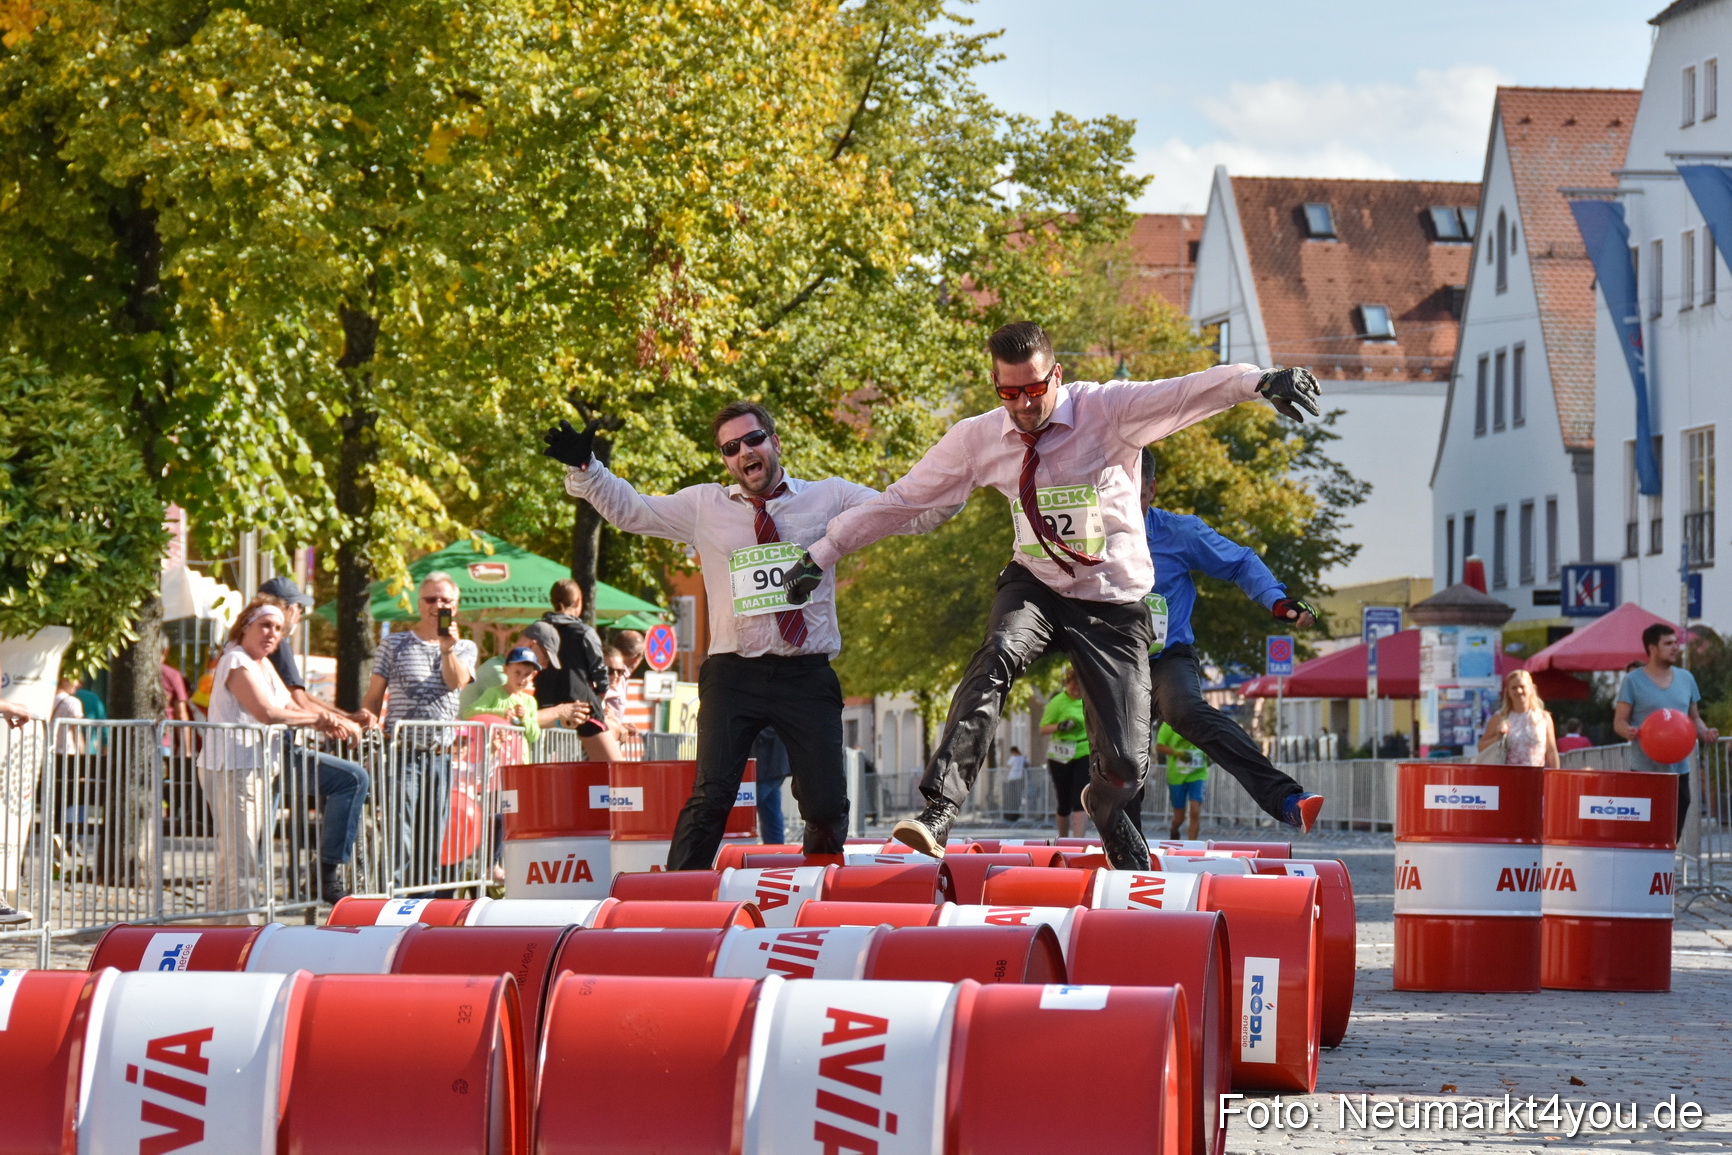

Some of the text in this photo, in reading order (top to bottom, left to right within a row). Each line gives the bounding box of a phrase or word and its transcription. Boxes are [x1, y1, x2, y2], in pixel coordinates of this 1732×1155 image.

[1036, 487, 1091, 510] OCK
[734, 544, 799, 569] BOCK
[460, 585, 544, 594] eumarkter
[753, 567, 785, 590] 90
[458, 594, 550, 604] mmsbrä
[1395, 859, 1422, 890] VIA
[1542, 861, 1577, 891] VIA
[1649, 871, 1674, 896] AV
[755, 867, 800, 912] VIA
[1127, 874, 1166, 910] AV
[177, 944, 193, 972] nergie
[758, 930, 831, 979] VIA
[125, 1026, 214, 1155] VIA
